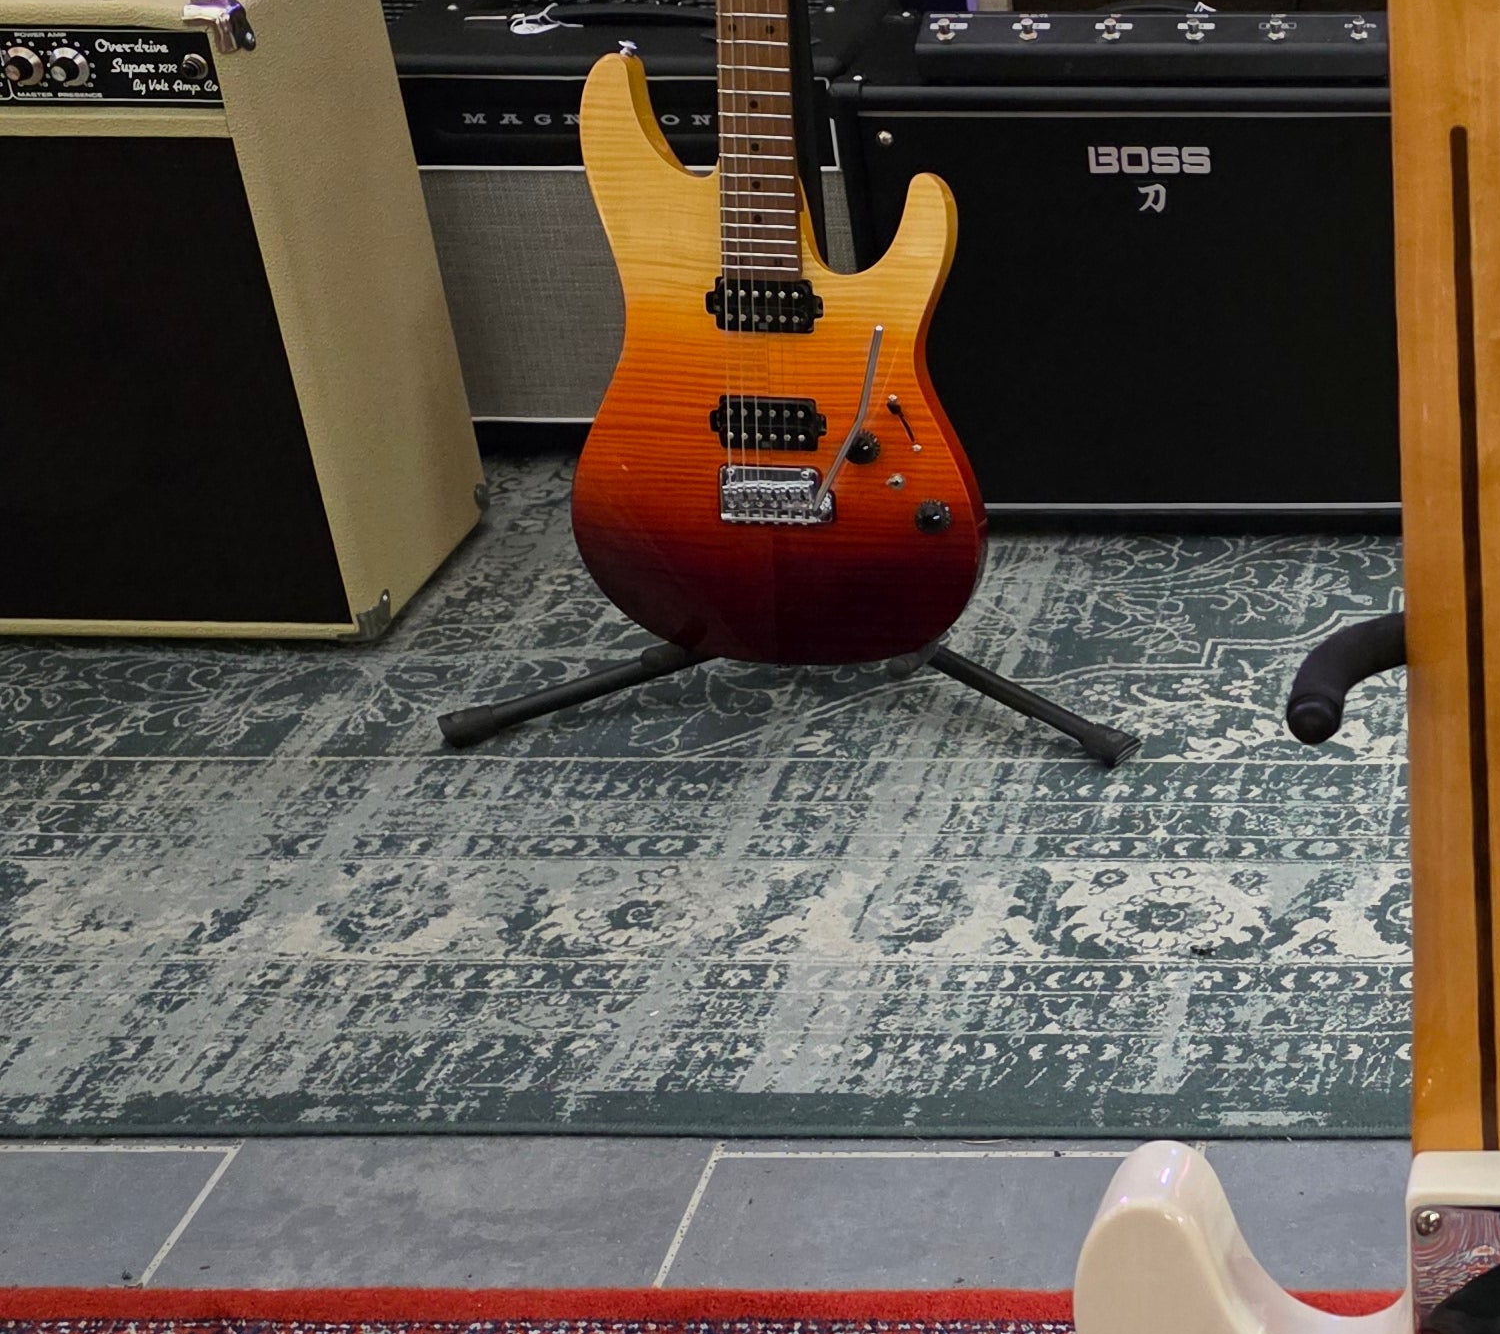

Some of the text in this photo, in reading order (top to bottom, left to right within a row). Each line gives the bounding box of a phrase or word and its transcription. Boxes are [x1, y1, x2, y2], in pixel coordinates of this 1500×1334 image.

[94, 38, 169, 54] Overdrive
[110, 57, 178, 79] Super RR
[132, 79, 219, 96] By Volt Amp Co
[1087, 145, 1212, 174] BOSS
